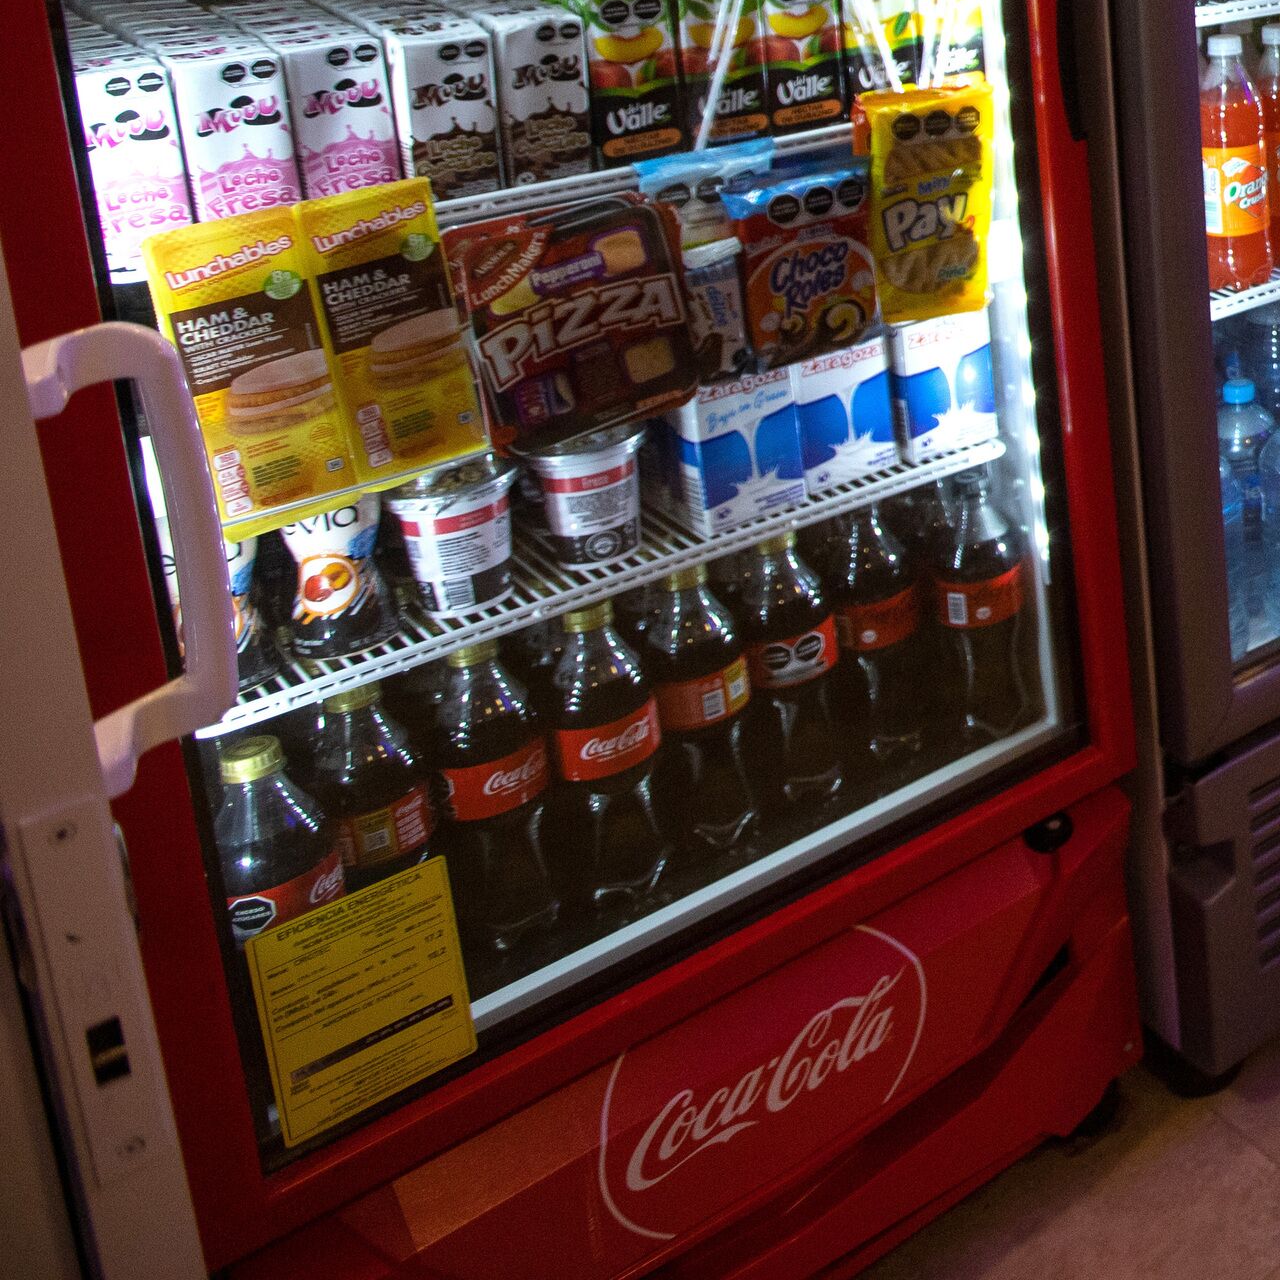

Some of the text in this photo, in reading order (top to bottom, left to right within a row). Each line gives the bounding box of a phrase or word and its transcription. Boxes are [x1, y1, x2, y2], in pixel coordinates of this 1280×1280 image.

[776, 75, 832, 106] Valle
[606, 103, 670, 136] Valle
[324, 151, 382, 174] Leche
[219, 168, 281, 194] Leche
[313, 168, 398, 197] Fresa
[207, 188, 298, 218] Fresa
[770, 242, 850, 295] Choco
[322, 273, 371, 295] HAM
[326, 273, 411, 306] CHEDDAR
[177, 307, 248, 334] HAM &
[180, 311, 276, 345] CHEDDAR
[625, 966, 908, 1191] Coca-Cola
